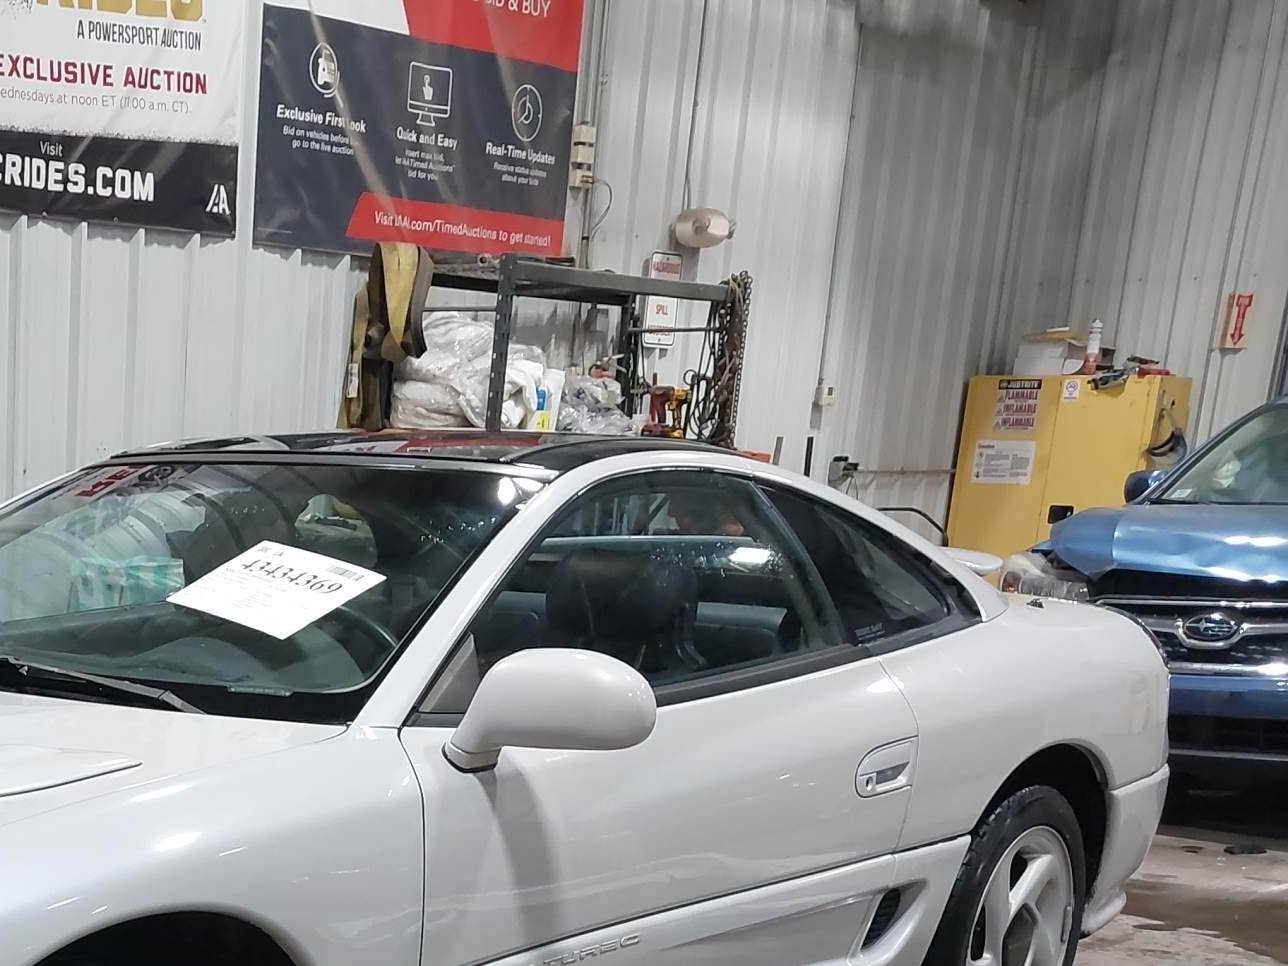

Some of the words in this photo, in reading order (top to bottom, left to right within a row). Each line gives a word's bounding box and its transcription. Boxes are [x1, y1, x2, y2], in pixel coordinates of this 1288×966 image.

[522, 0, 551, 18] BUY
[77, 19, 85, 39] A
[88, 21, 160, 45] POWERSPORT
[161, 27, 202, 51] AUCTION
[123, 66, 208, 95] AUCTION
[56, 94, 68, 105] at
[71, 95, 98, 107] noon
[102, 95, 116, 108] ET
[276, 104, 324, 124] Exclusive
[40, 140, 63, 157] Visit
[396, 126, 417, 143] Quick
[419, 133, 435, 145] and
[437, 134, 458, 151] Easy
[486, 141, 526, 160] Real-Time
[527, 148, 556, 165] Updates
[374, 210, 394, 226] Visit
[499, 229, 508, 241] to
[509, 231, 523, 245] get
[240, 558, 344, 595] 43434369
